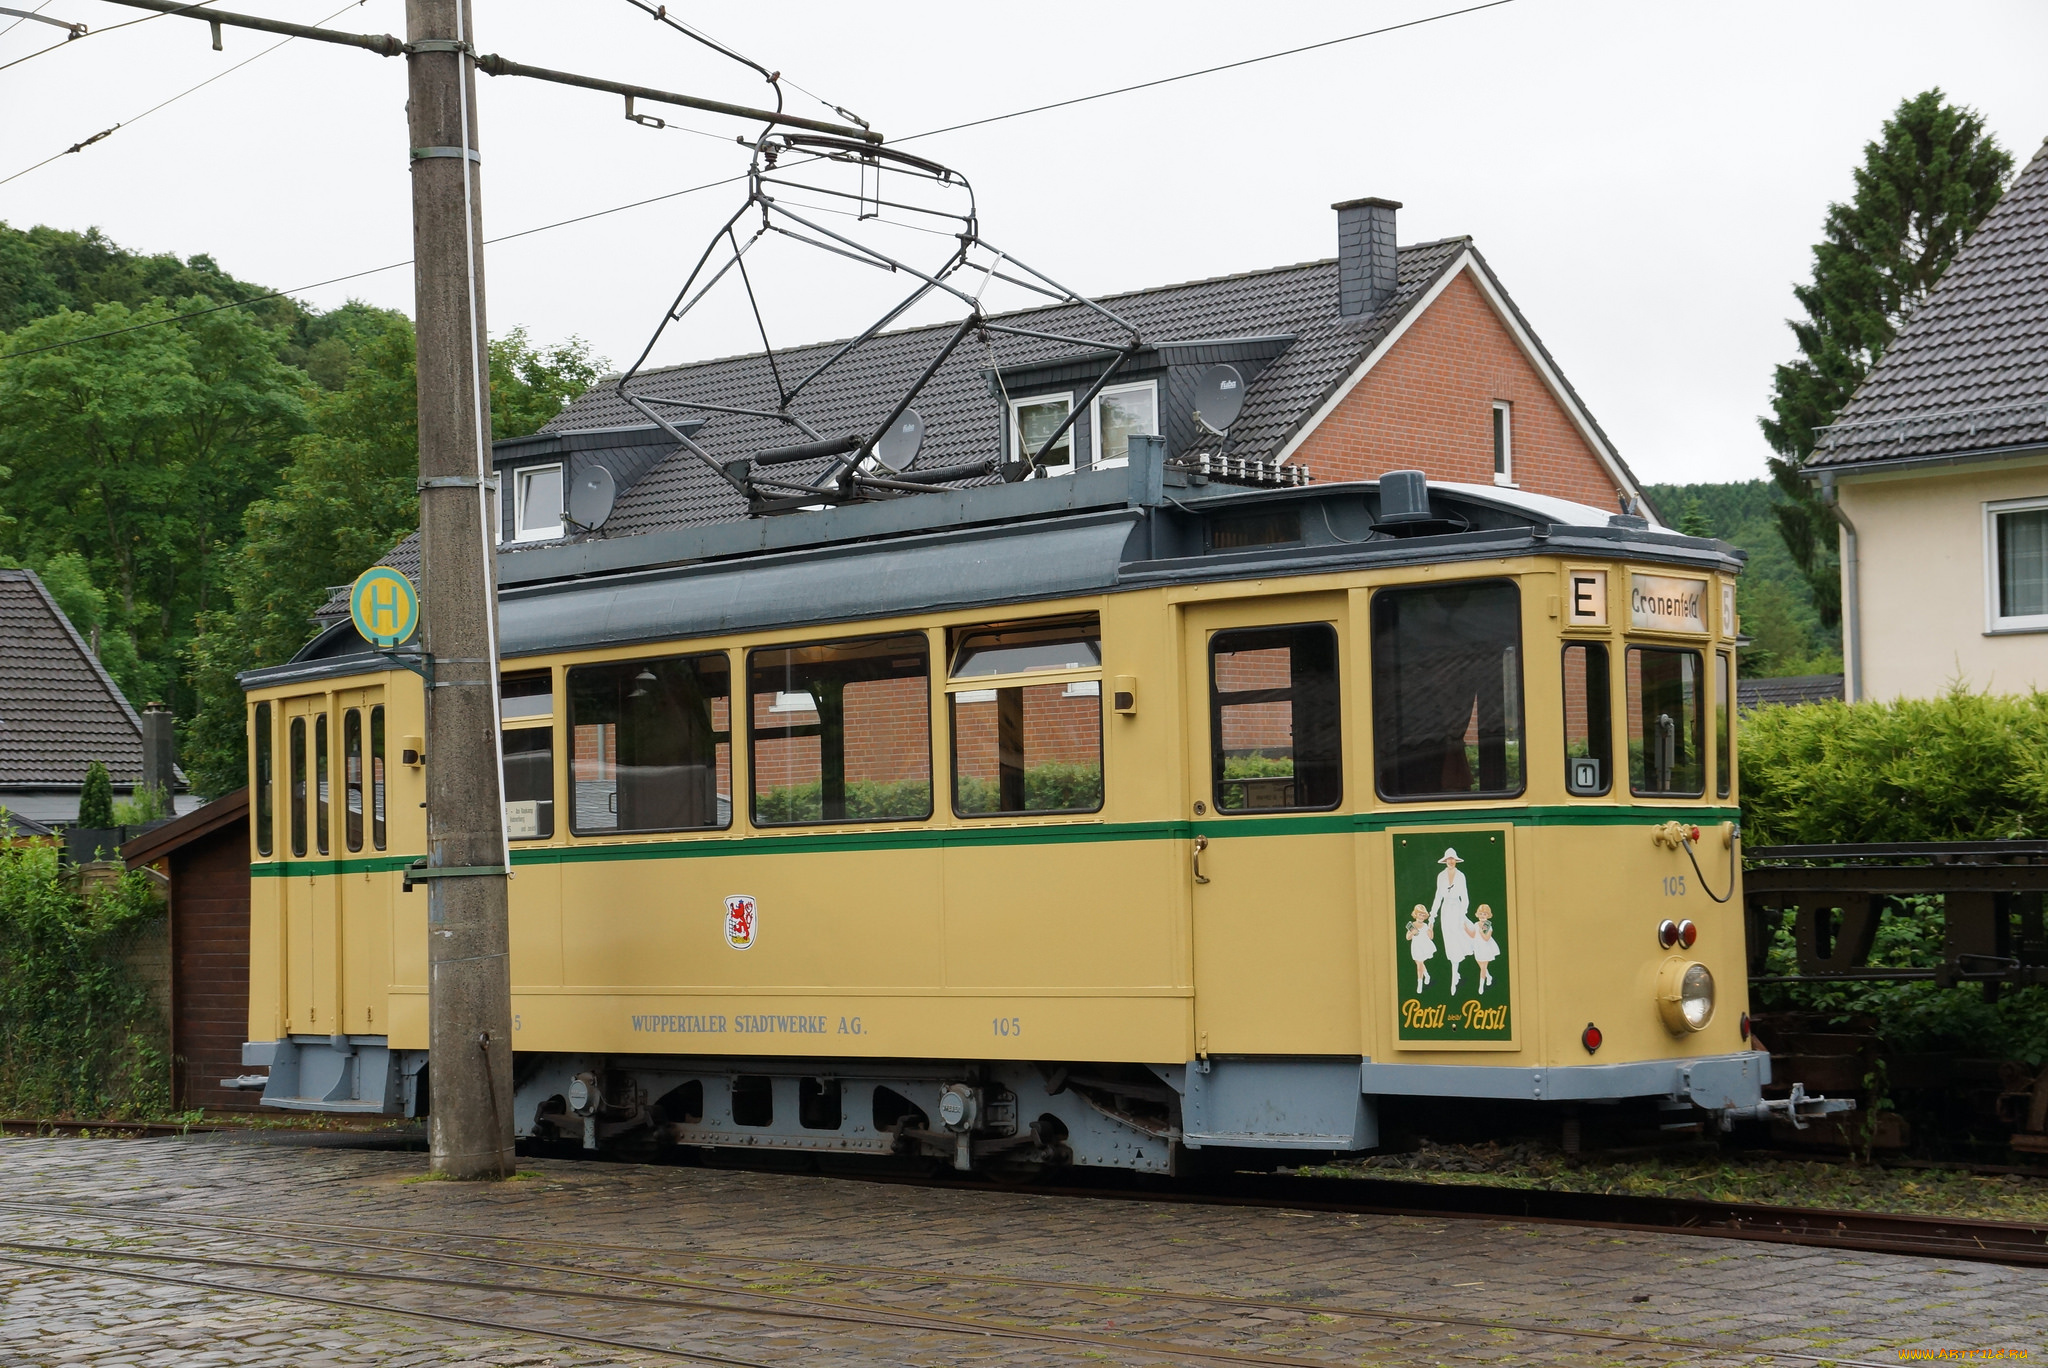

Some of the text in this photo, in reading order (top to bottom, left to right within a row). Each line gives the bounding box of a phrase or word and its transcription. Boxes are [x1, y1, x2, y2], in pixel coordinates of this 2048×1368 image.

[371, 585, 398, 628] H
[1574, 577, 1596, 617] E
[1631, 587, 1699, 618] Cronenfeld
[1723, 590, 1731, 630] 5
[1582, 767, 1588, 784] 1
[1663, 876, 1686, 896] 105
[631, 1015, 868, 1035] WUPPERTALER STADTWERKE AG.
[992, 1017, 1021, 1036] 105
[1402, 999, 1446, 1028] Persil
[1462, 1000, 1507, 1029] Persil
